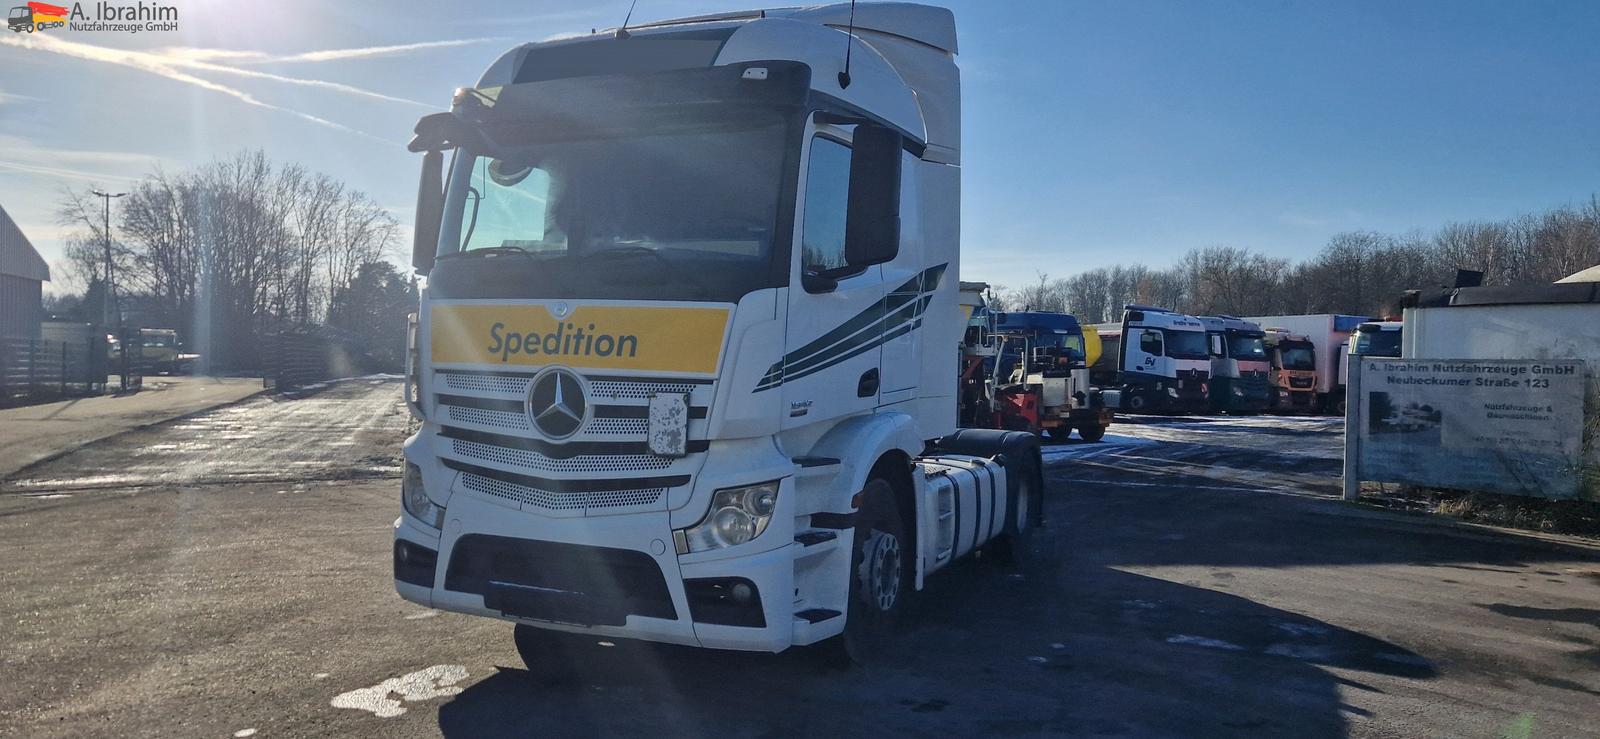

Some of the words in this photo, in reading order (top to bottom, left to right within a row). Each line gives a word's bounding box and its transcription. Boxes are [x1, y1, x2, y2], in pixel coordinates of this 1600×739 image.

[488, 322, 638, 361] Spedition
[1369, 363, 1380, 372] A.
[1384, 363, 1429, 373] Ibrahim
[1432, 364, 1527, 375] Nutzfahrzeuge
[1531, 365, 1575, 375] GmbH
[1387, 375, 1471, 386] Neubeckumer
[1475, 378, 1520, 388] Straße
[1524, 379, 1550, 388] 123
